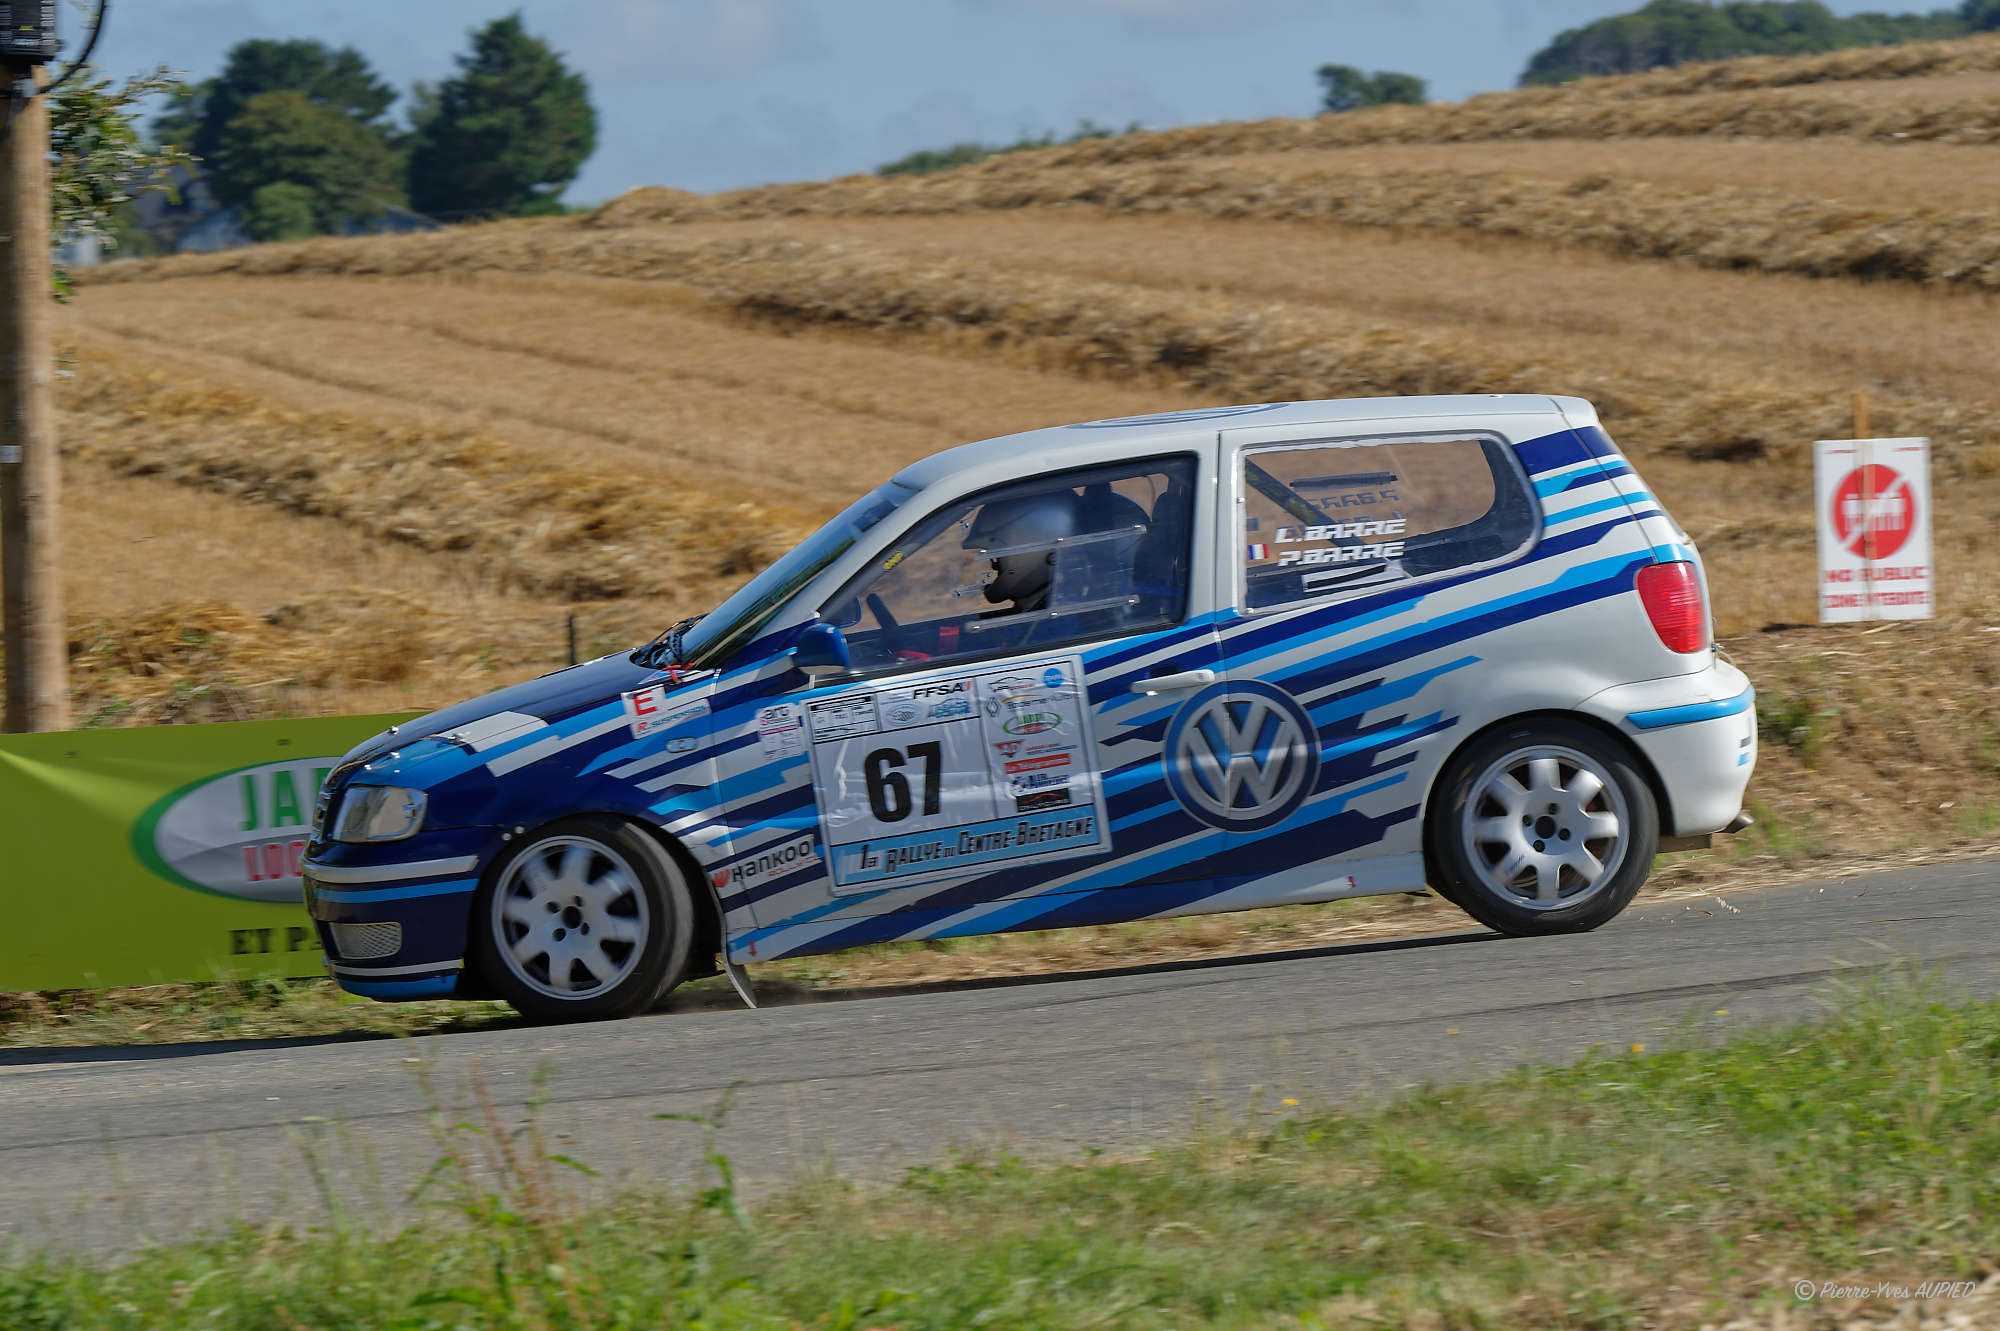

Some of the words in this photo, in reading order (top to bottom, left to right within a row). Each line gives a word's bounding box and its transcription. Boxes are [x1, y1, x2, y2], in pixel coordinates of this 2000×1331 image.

[1274, 519, 1407, 543] L.BARRE
[1278, 541, 1405, 566] P.BARRE
[633, 690, 657, 716] E
[913, 681, 964, 699] FFSA
[864, 741, 946, 823] 67
[886, 841, 943, 874] RALLYE
[957, 817, 1094, 856] CENTRE-BRETAGNE
[230, 929, 272, 955] ET
